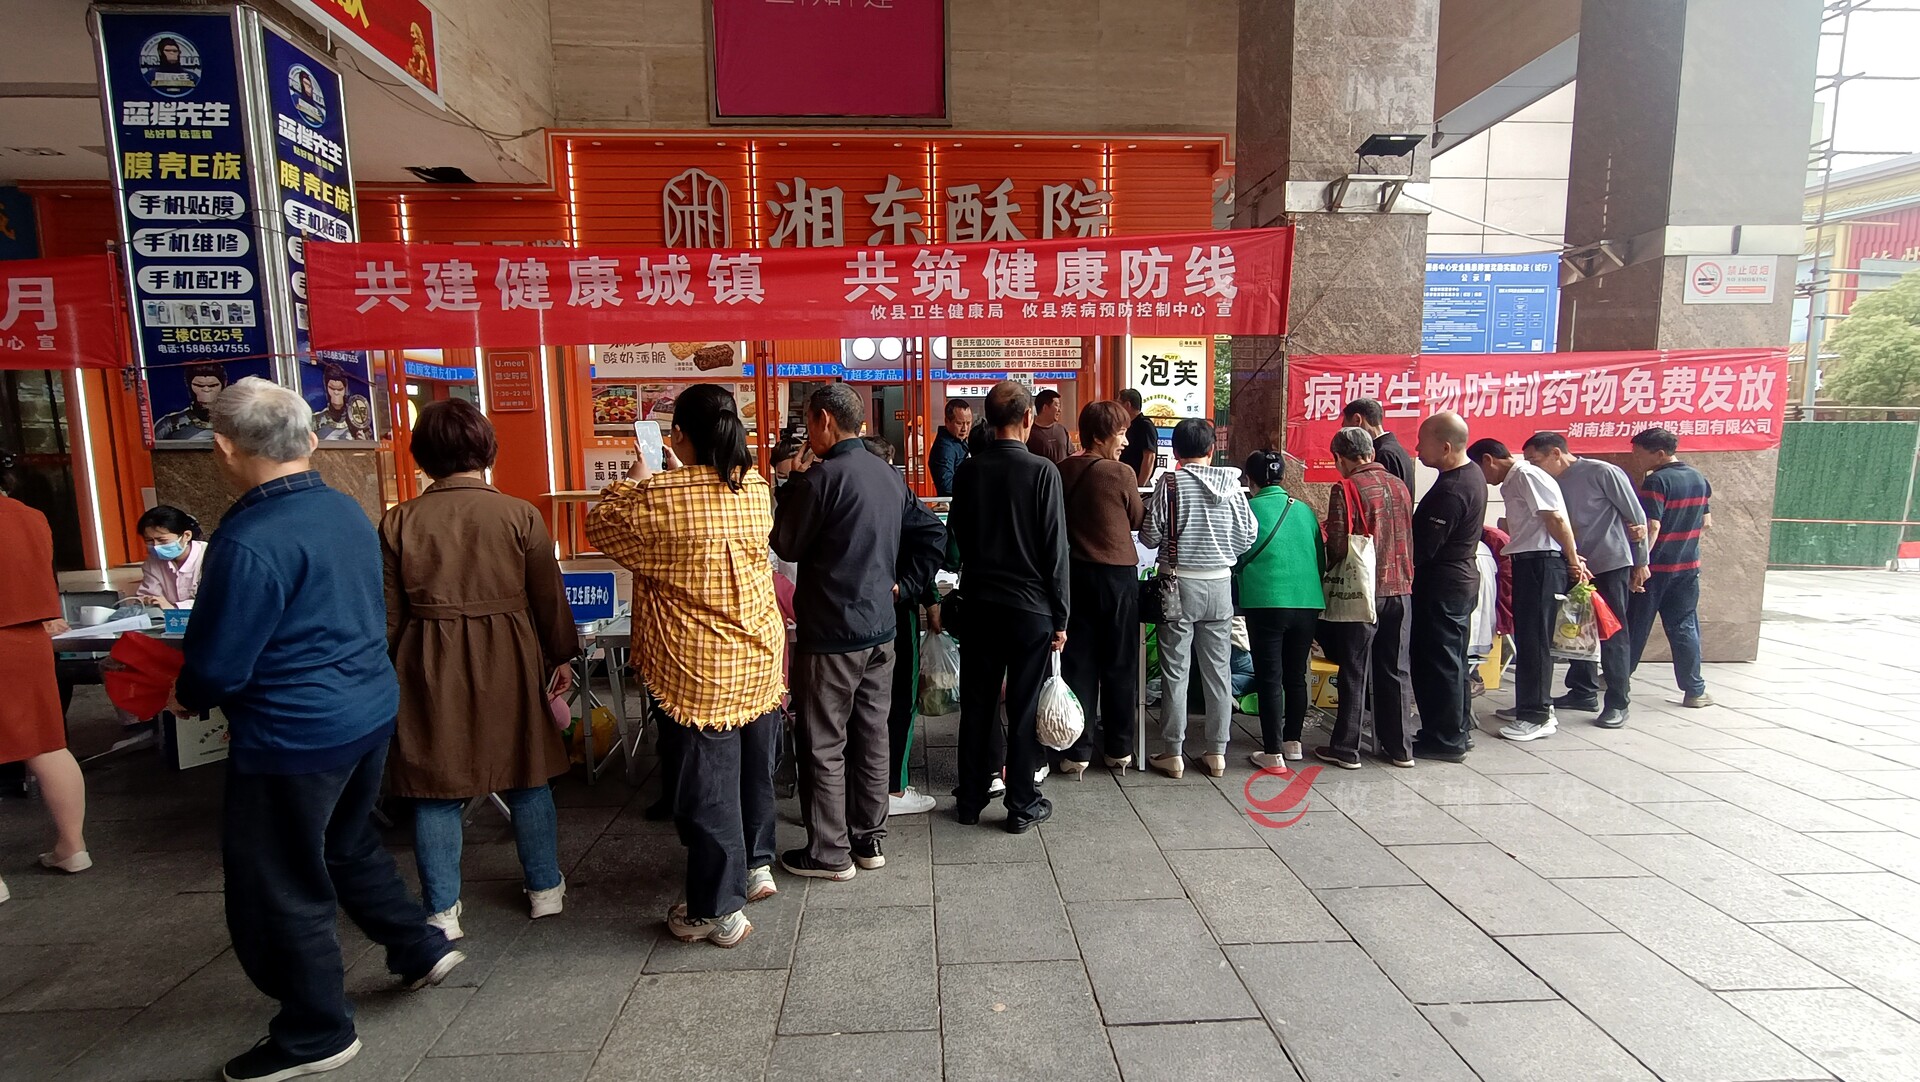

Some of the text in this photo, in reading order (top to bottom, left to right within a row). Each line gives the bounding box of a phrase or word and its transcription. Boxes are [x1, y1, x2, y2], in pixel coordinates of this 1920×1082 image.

[139, 195, 235, 216] 手机贴膜
[767, 174, 1113, 248] 湘东酥院
[291, 204, 348, 243] 手机贴膜
[144, 233, 239, 253] 手机维修
[148, 270, 242, 290] 手机配件
[355, 245, 1239, 313] 共建健康城镇 共筑健康防线
[1727, 265, 1769, 275] 禁止吸烟
[0, 276, 58, 331] 月
[870, 300, 1232, 320] 攸县卫生健康局 攸县疾病预防控制中心 宣
[38, 334, 56, 350] 宣
[161, 328, 244, 342] 三楼C区25号
[157, 344, 251, 354] 电话:15886347555
[1140, 354, 1198, 387] 泡芙
[1304, 365, 1777, 421] 病媒生物防制药物免费发放
